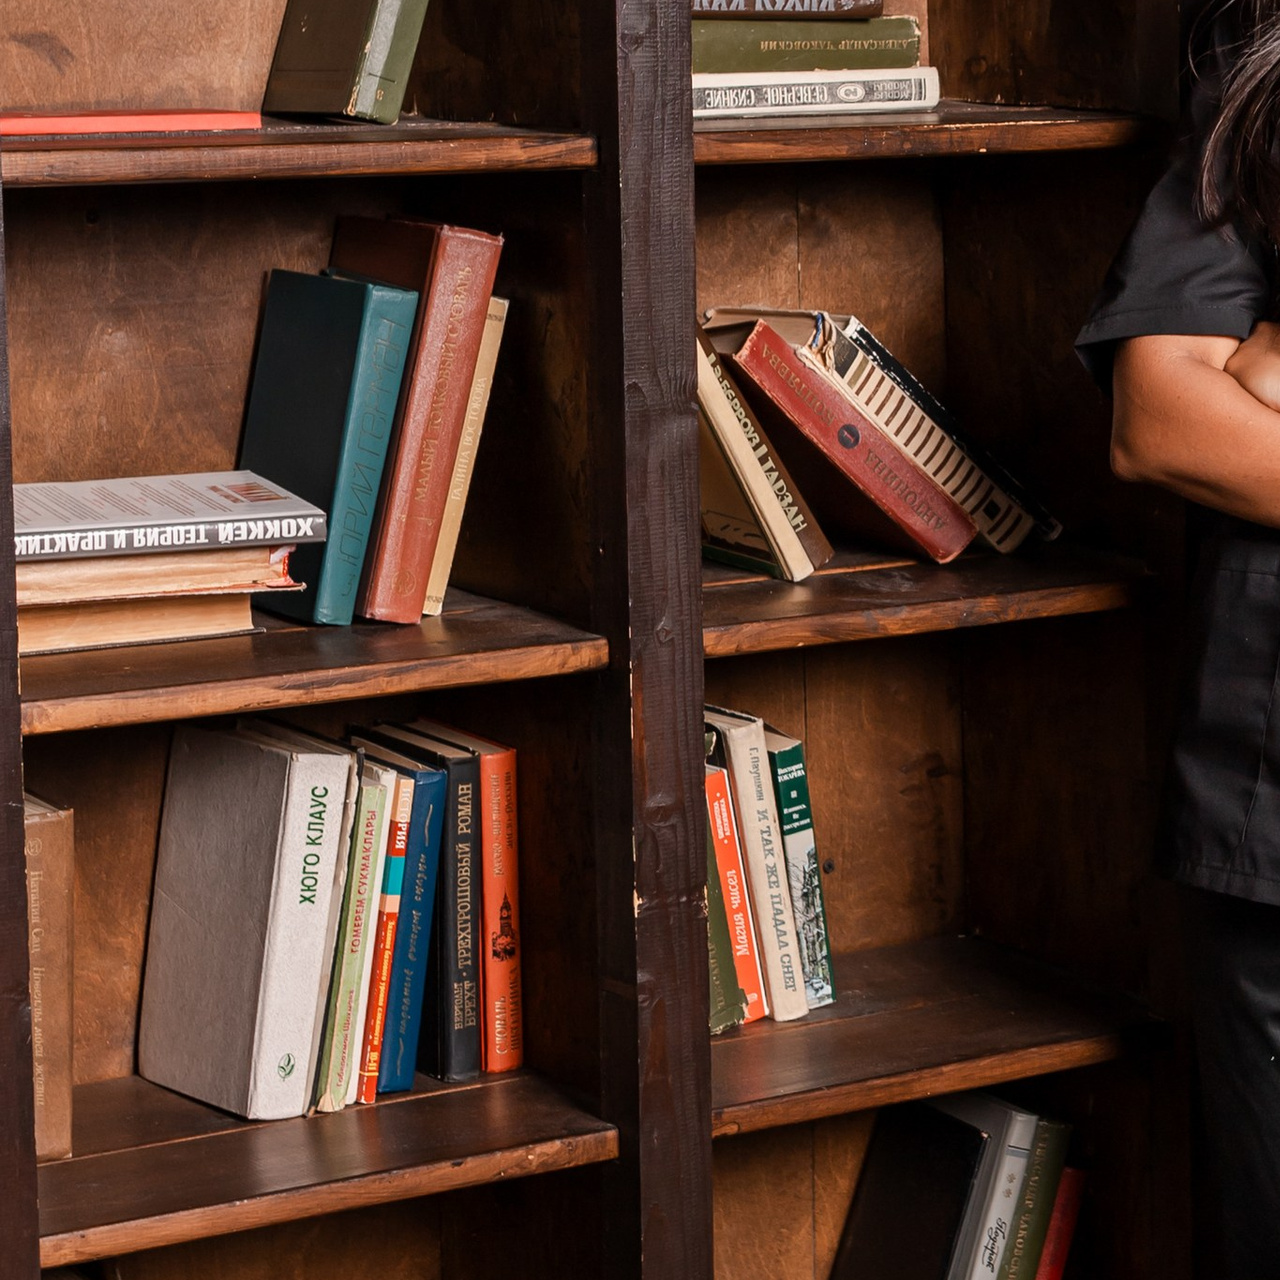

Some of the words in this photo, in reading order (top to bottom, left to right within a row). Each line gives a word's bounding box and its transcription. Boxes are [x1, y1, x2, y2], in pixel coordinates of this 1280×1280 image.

[760, 39, 836, 53] ЧАКОВСКИЙ
[839, 38, 909, 53] АЛЕКСАНДР
[705, 89, 755, 108] СИЯНИЕ
[763, 85, 828, 104] СЕВЕРНОЕ
[414, 435, 440, 503] МАЛЫЙ
[429, 338, 457, 431] ТОЛКОВЫЙ
[445, 266, 473, 336] СЛОВАРЬ
[762, 347, 836, 426] КОПТЯЕВА
[337, 458, 377, 570] ЮРИЙ
[363, 315, 408, 457] ГЕРМАН
[451, 449, 470, 501] ГАЛИНА
[464, 375, 488, 447] ВОСТОКОВА
[765, 461, 809, 535] ТАРЗАН
[863, 449, 949, 532] АНТОНИНА
[114, 524, 127, 549] И
[134, 520, 208, 549] ТЕОРИЯ
[305, 785, 330, 847] КЛАУС
[394, 786, 412, 851] ИСТОРИЯ
[457, 782, 473, 835] РОМАН
[758, 809, 770, 823] И
[358, 809, 378, 896] СУКМАКЛАРЫ
[759, 826, 775, 858] ТАК
[298, 848, 321, 905] ХЮГО
[727, 869, 745, 912] чисел
[766, 863, 781, 892] ЖЕ
[457, 842, 473, 969] ТРЕХГРОШОВЫЙ
[770, 894, 789, 951] ПАДАЛ
[731, 913, 750, 956] Магия
[33, 966, 44, 1022] Новеллы
[779, 953, 797, 993] СНЕГ
[454, 982, 464, 1030] БЕРТОЛЬТ
[464, 979, 475, 1027] БРЕХТ
[495, 995, 508, 1055] СЛОВАРЬ
[34, 1026, 43, 1058] моей
[35, 1061, 46, 1106] жизни
[981, 1216, 1006, 1274] Подарок
